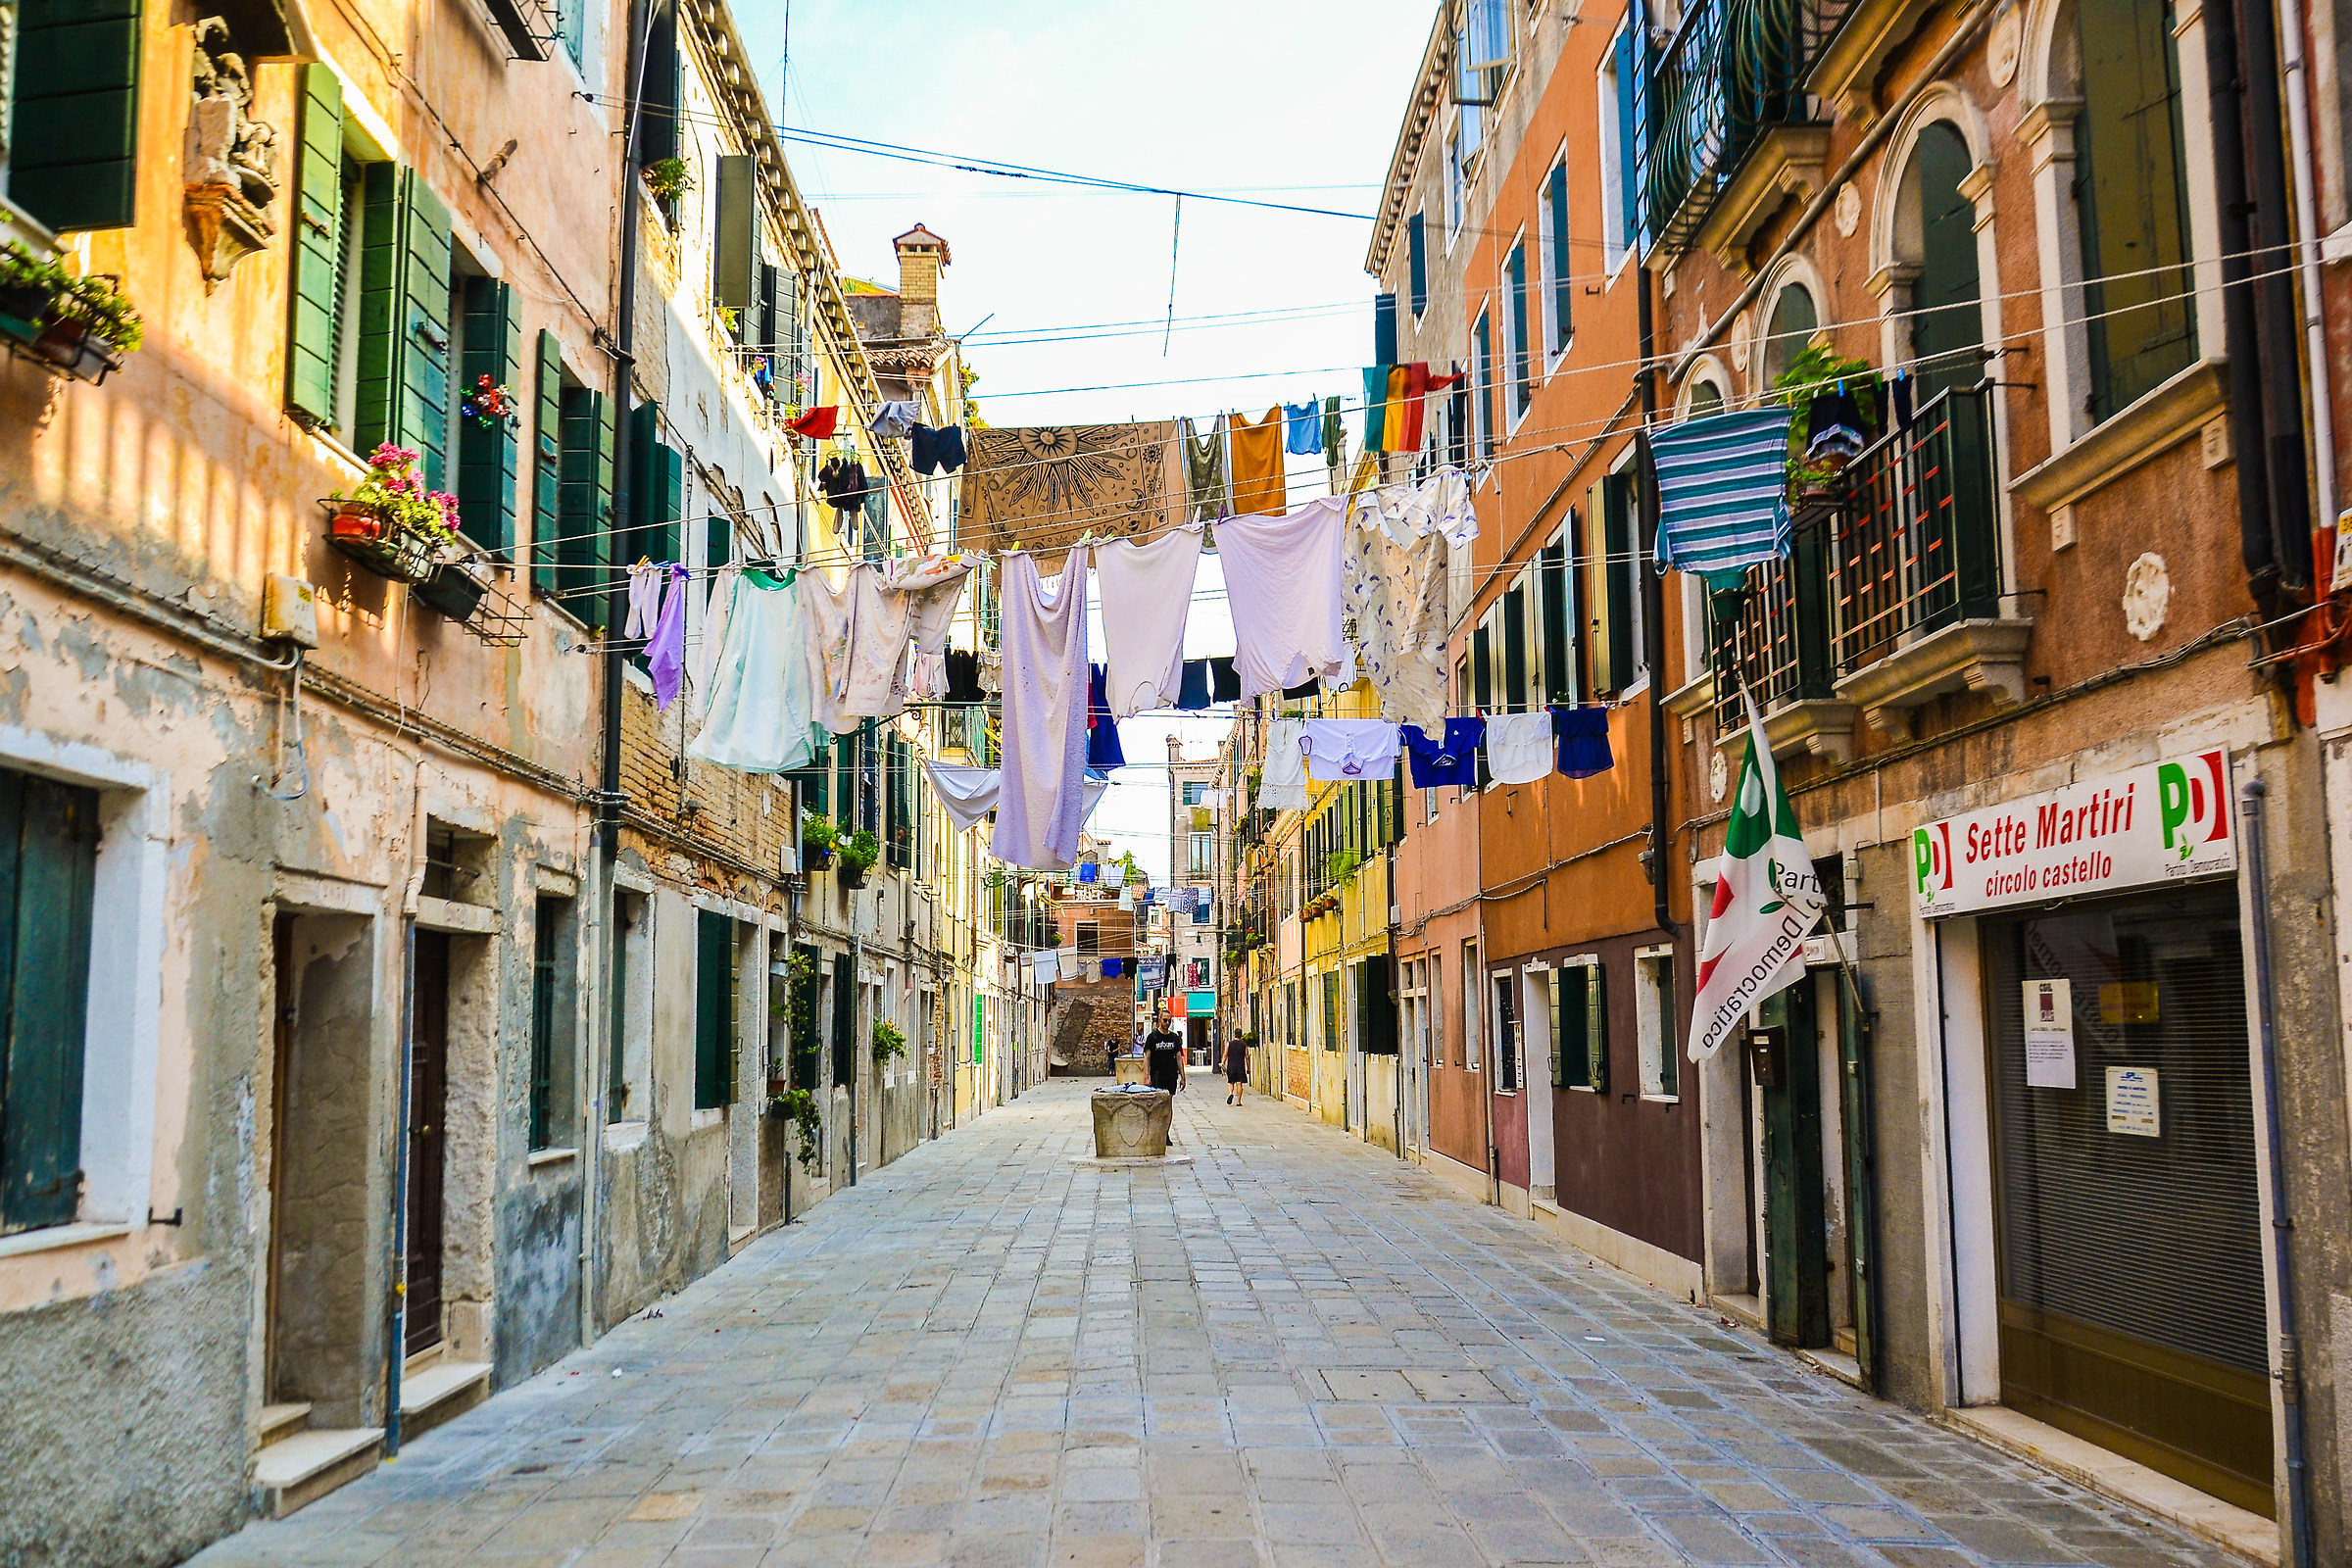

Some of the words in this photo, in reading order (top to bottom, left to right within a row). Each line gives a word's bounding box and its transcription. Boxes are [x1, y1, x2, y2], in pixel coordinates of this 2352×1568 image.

[1966, 815, 2026, 864] Sette
[2035, 782, 2134, 850] Martiri
[1775, 861, 1823, 894] Part
[1985, 863, 2036, 898] circolo
[2042, 851, 2112, 889] castello
